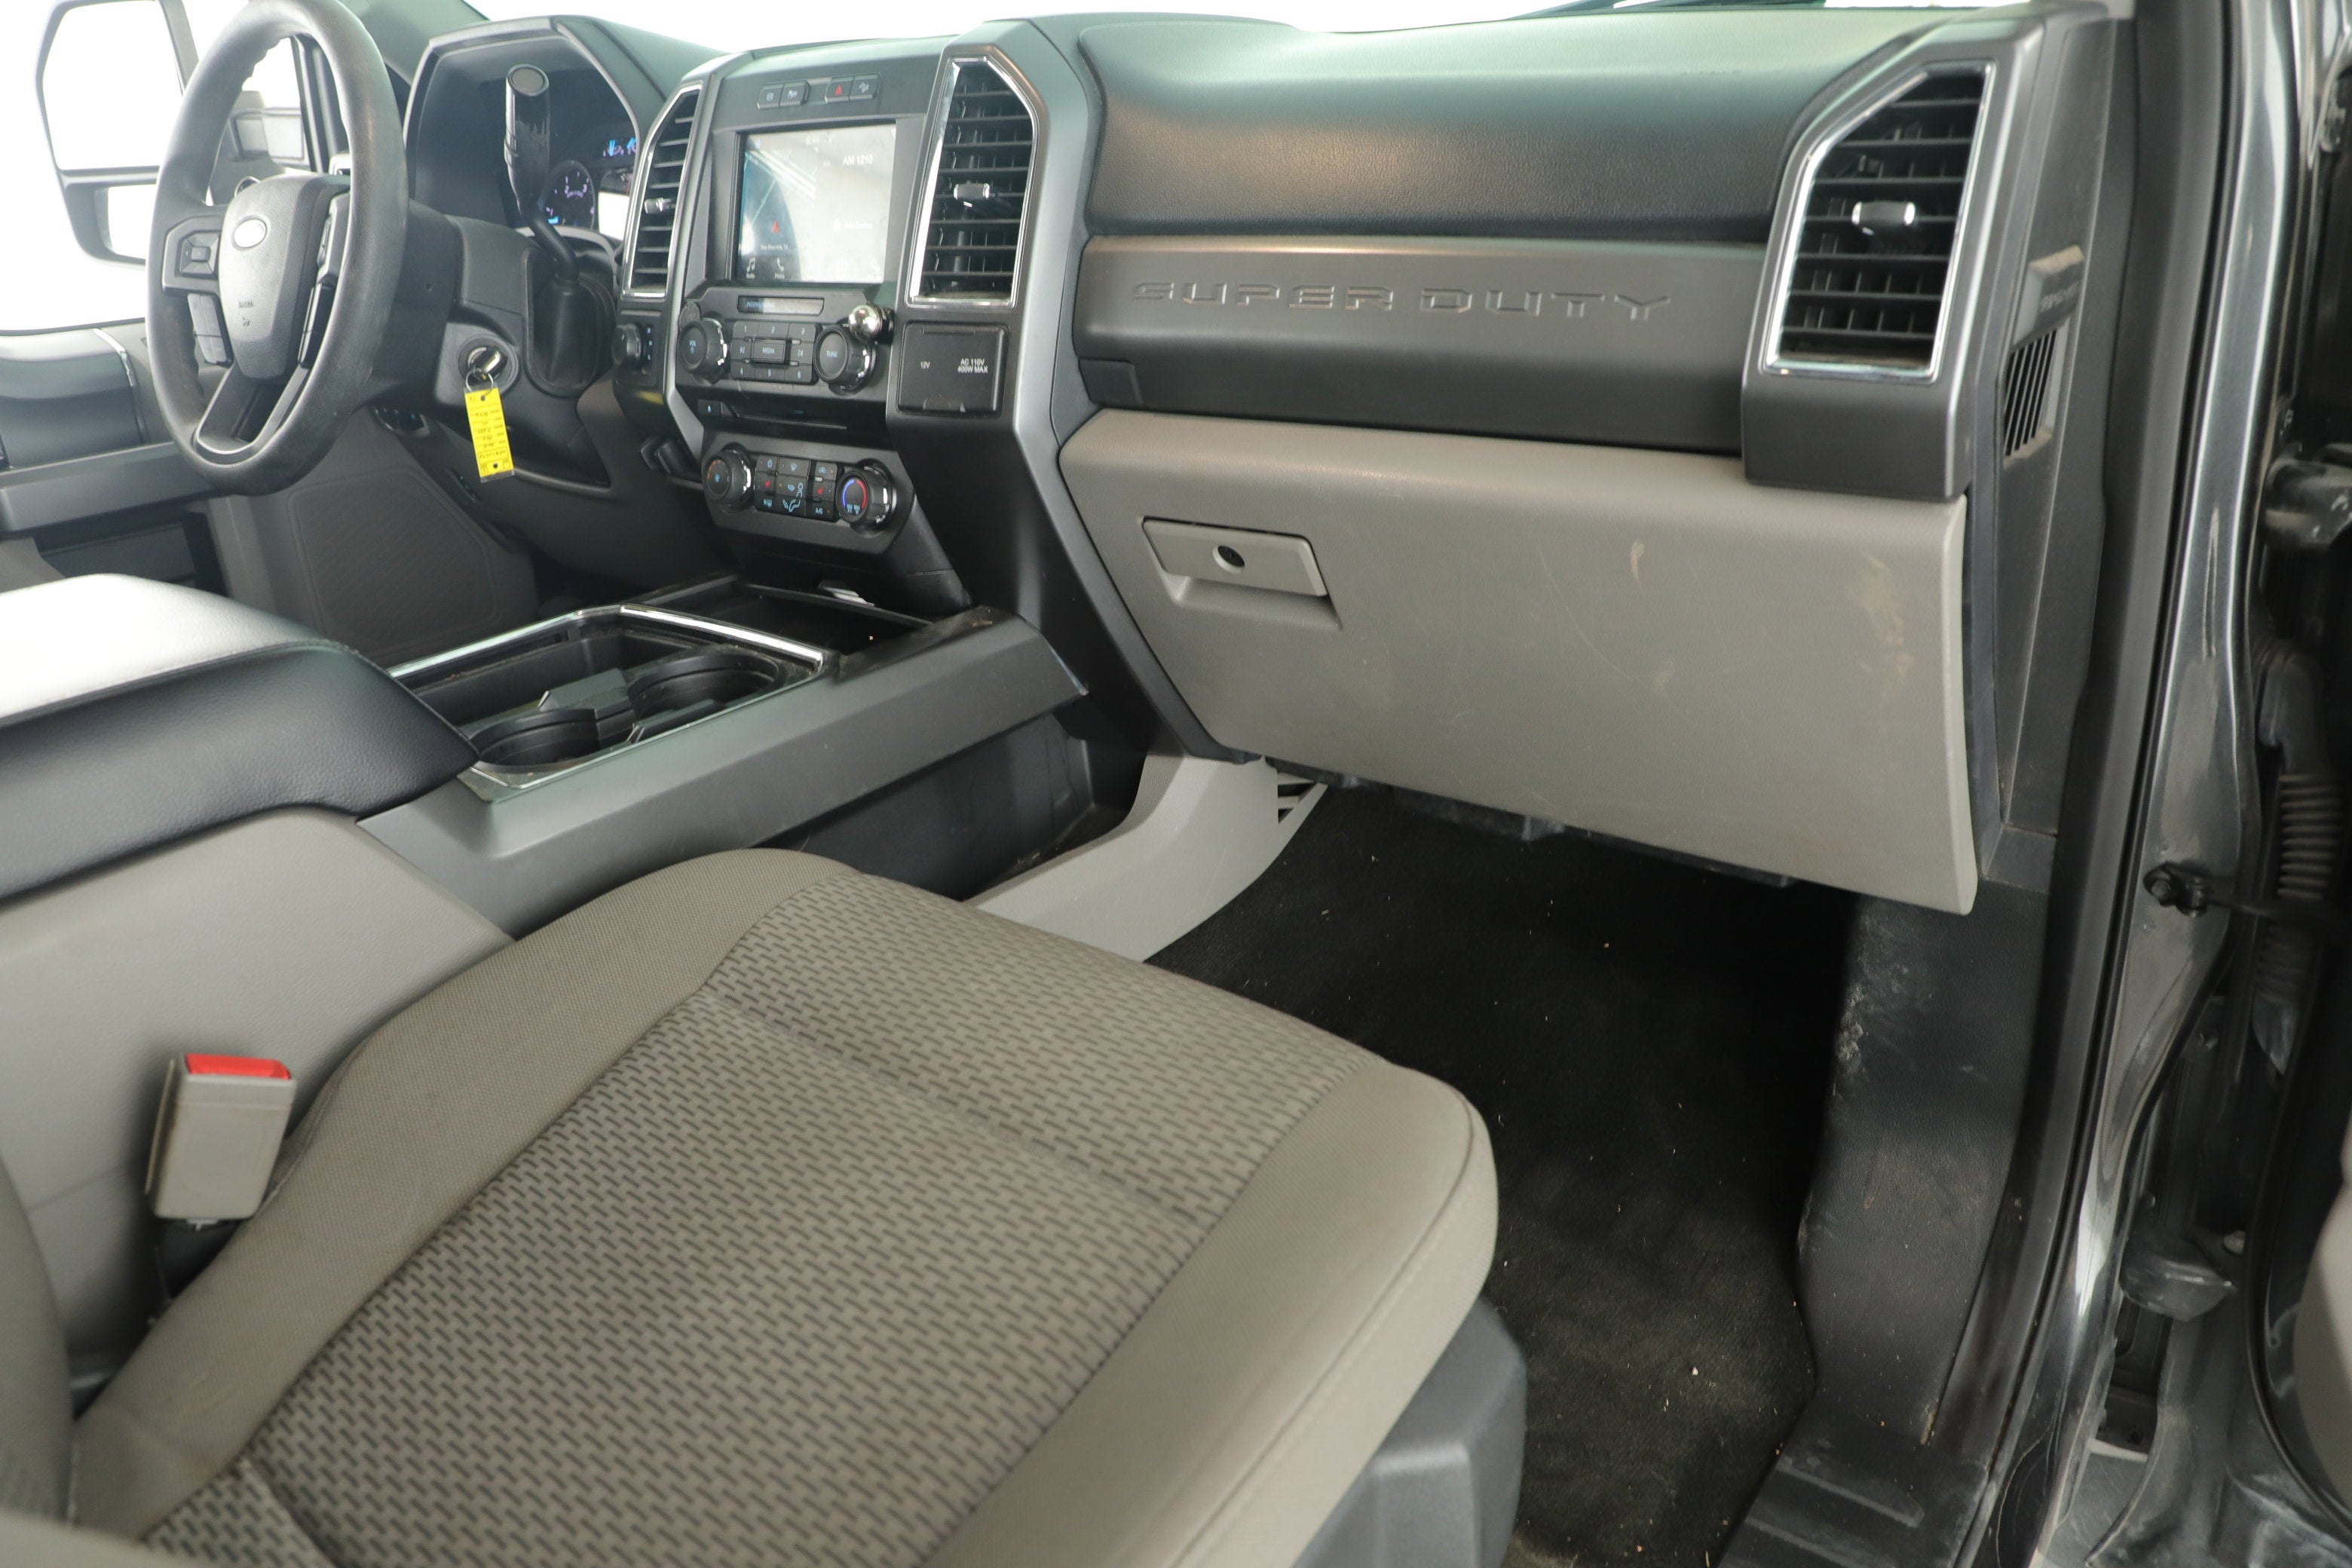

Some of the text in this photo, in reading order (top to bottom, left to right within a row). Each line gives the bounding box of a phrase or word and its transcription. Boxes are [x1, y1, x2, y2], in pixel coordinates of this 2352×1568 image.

[843, 155, 855, 165] AM
[1132, 282, 1671, 321] SUPER DUTY
[825, 350, 838, 359] TUNE
[970, 358, 985, 367] 110V
[957, 365, 989, 374] 400W MAX
